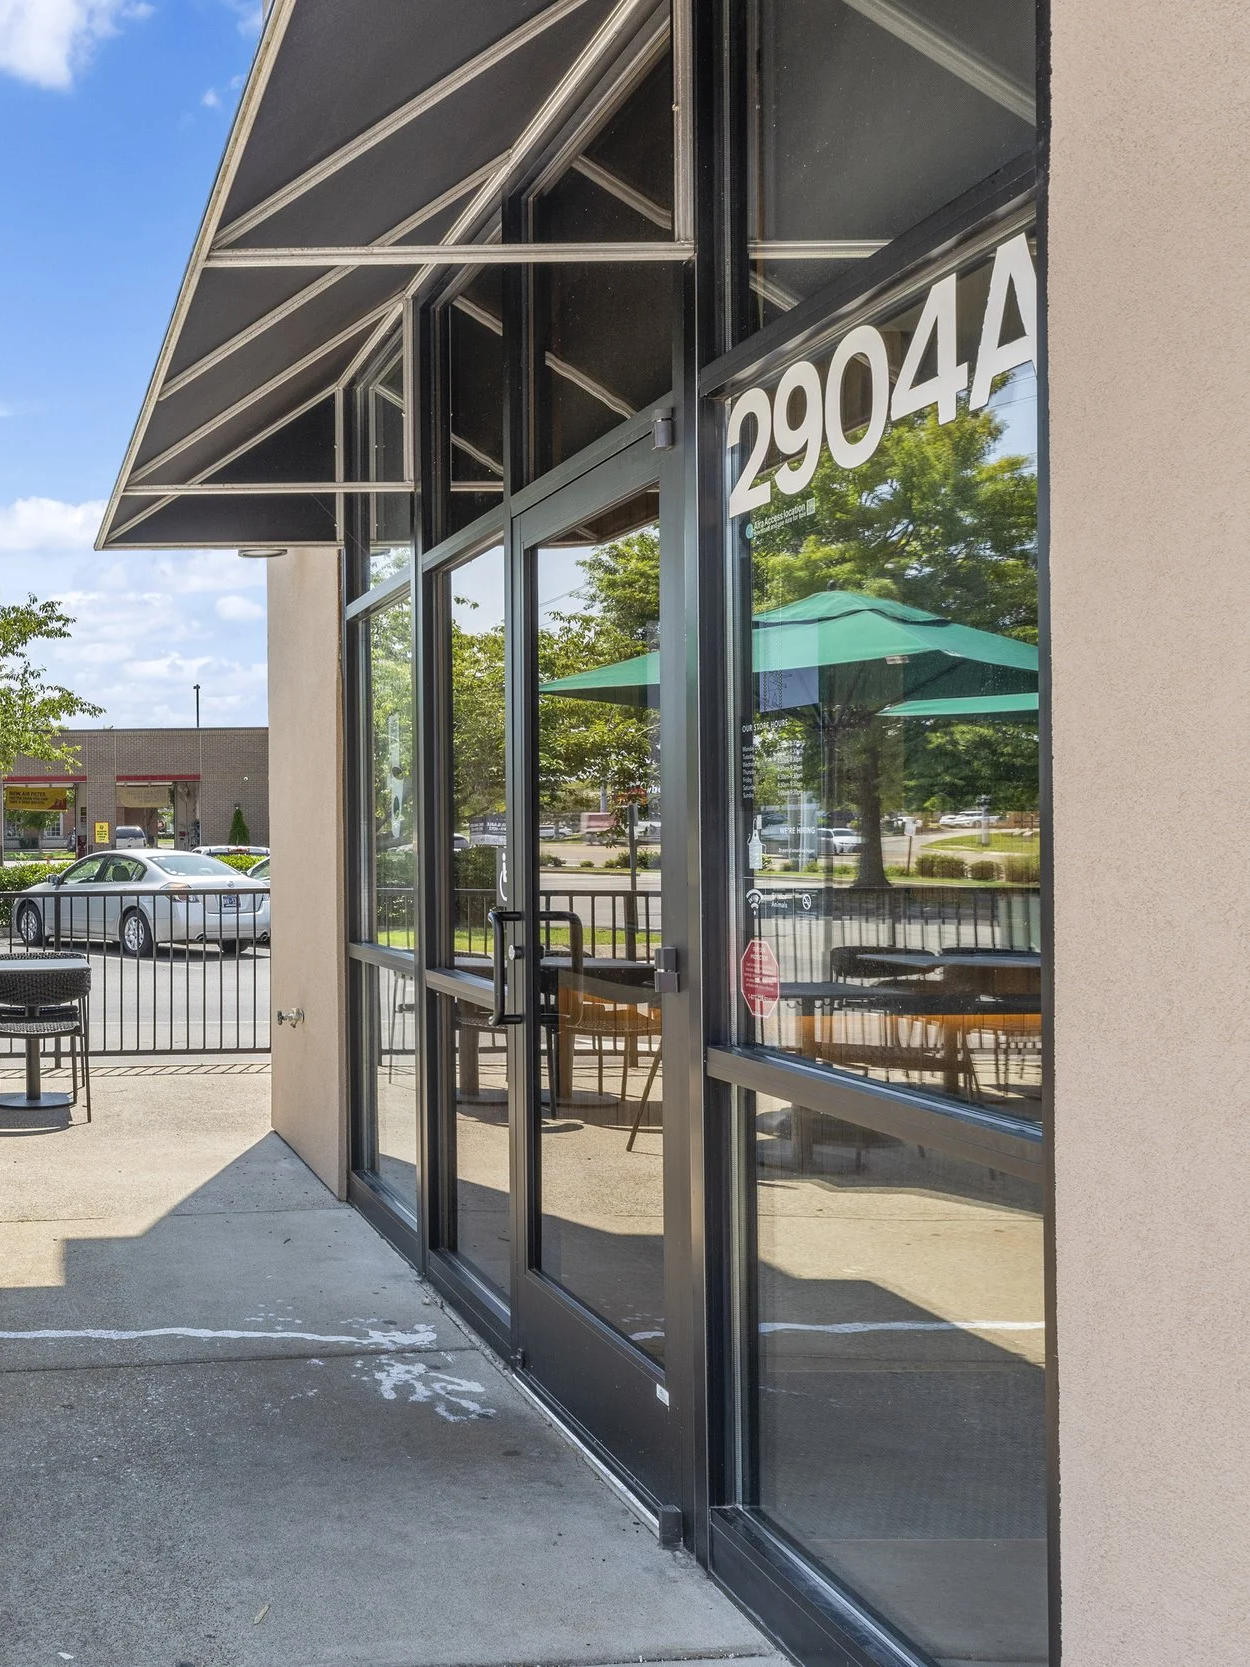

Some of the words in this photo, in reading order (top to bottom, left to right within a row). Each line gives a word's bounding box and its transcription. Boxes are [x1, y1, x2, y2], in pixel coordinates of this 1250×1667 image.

[727, 233, 1037, 518] 2904A
[765, 512, 783, 526] Access
[783, 503, 806, 519] location
[742, 724, 753, 733] OUR
[753, 721, 770, 731] STORE
[770, 718, 788, 729] HOURS
[780, 826, 796, 835] WE'RE
[771, 901, 788, 909] Animals
